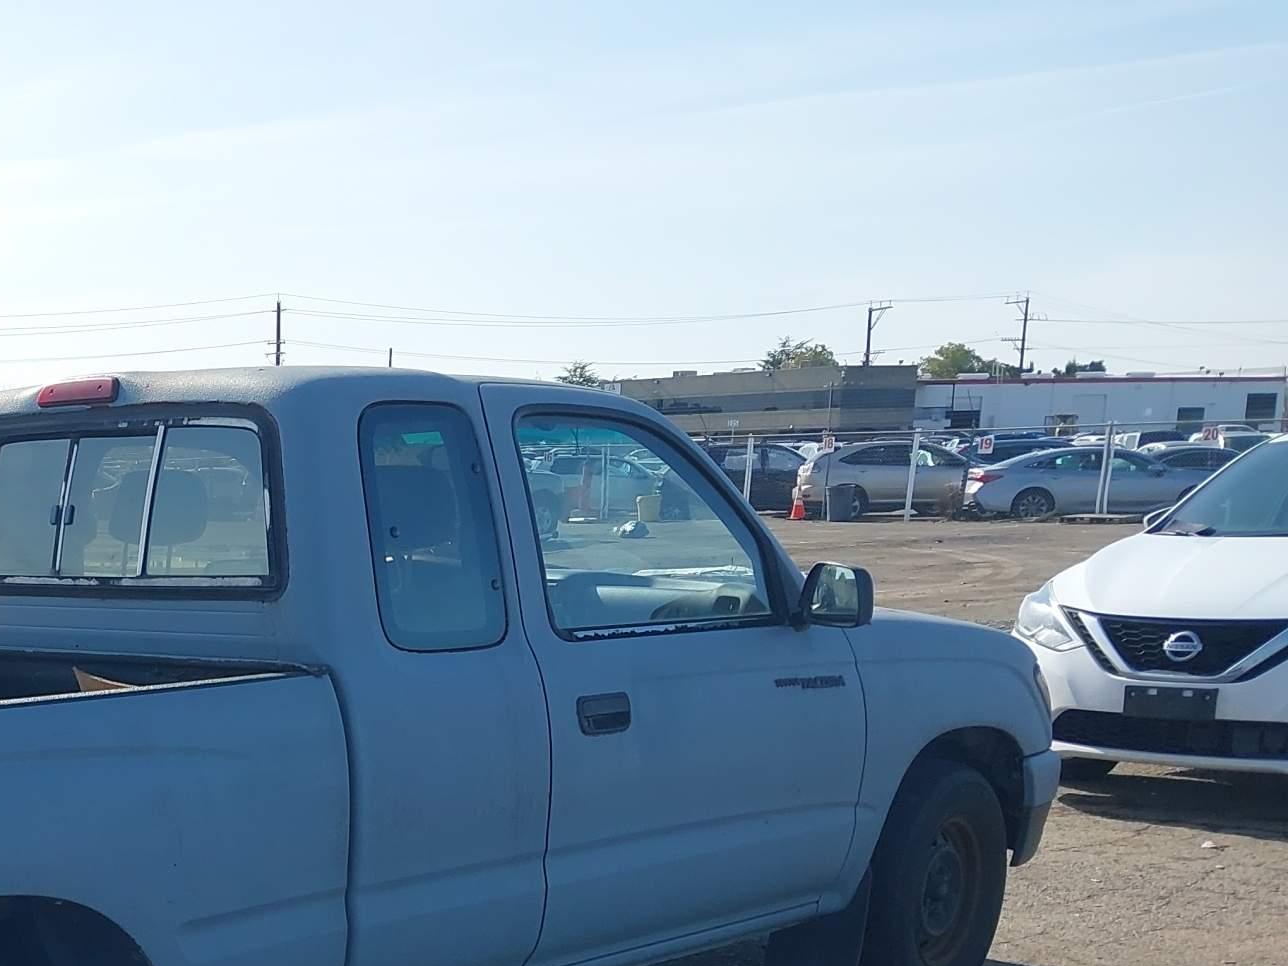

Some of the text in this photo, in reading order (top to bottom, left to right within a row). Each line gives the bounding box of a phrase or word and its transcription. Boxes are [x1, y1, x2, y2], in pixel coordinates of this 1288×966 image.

[1203, 427, 1219, 441] 20
[823, 437, 834, 450] 18
[979, 437, 993, 450] 19
